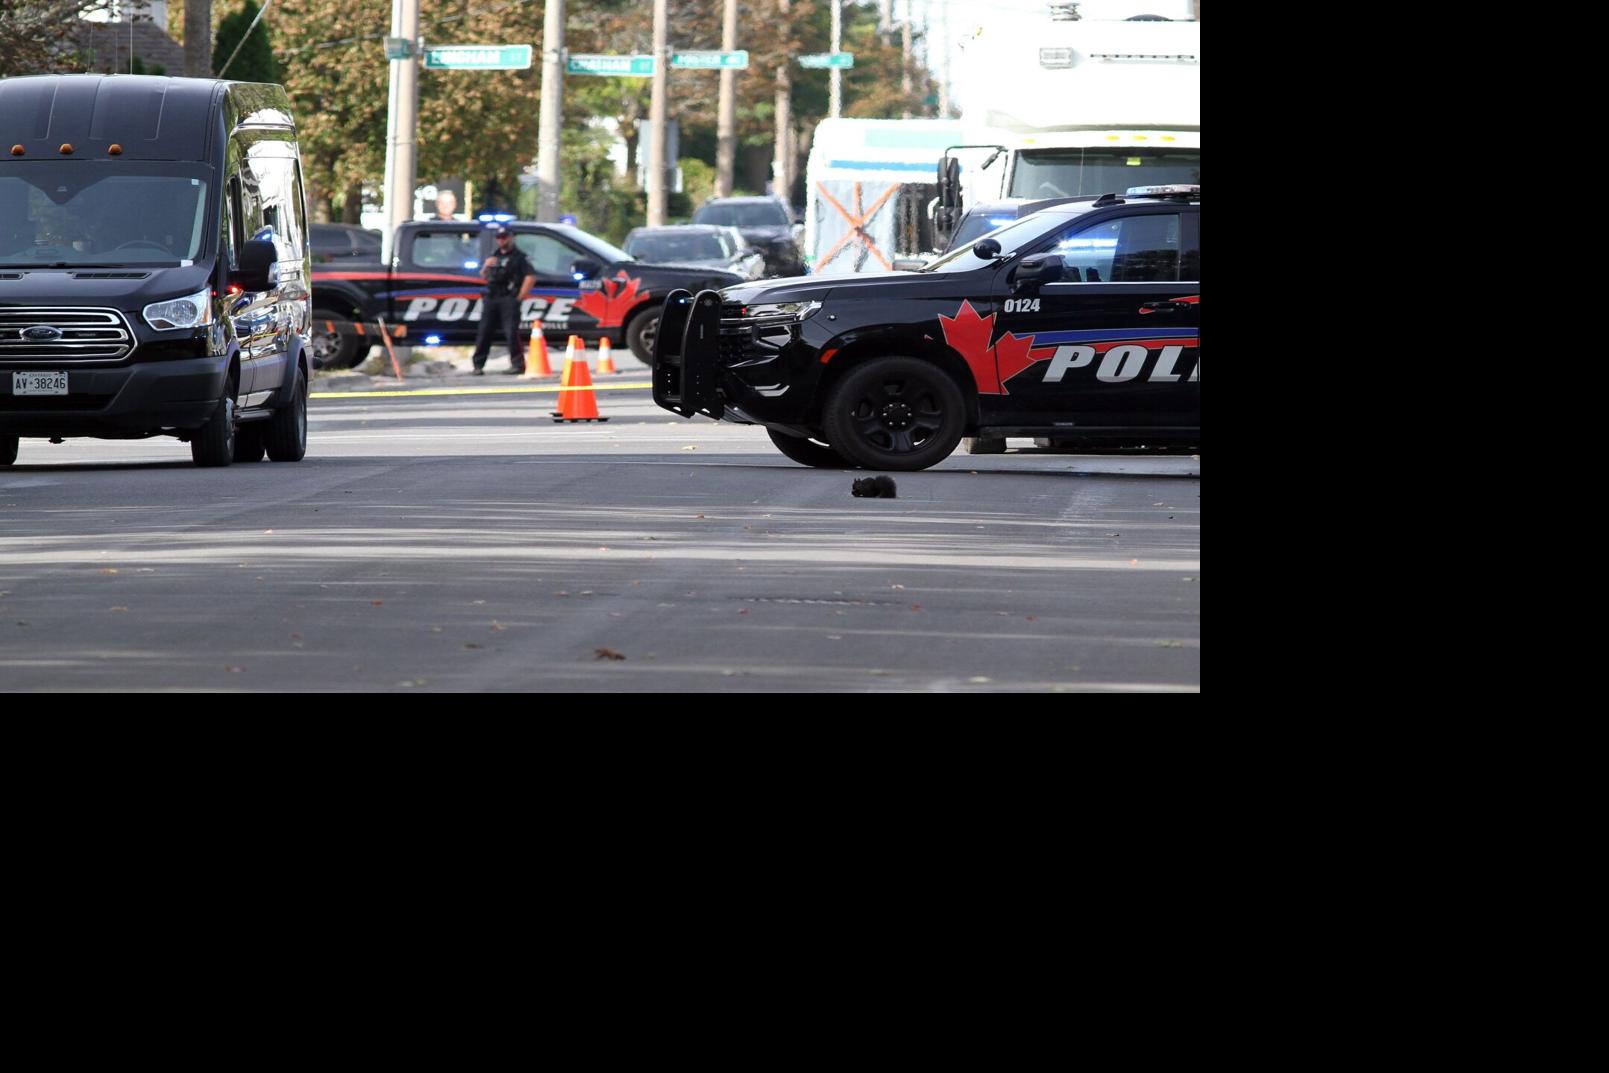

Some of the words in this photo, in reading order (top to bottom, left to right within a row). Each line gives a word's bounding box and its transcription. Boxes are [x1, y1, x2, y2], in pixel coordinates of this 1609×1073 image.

[403, 297, 576, 322] POLCE
[1004, 298, 1041, 313] 0124
[1042, 345, 1201, 383] POL
[34, 377, 66, 389] 38246
